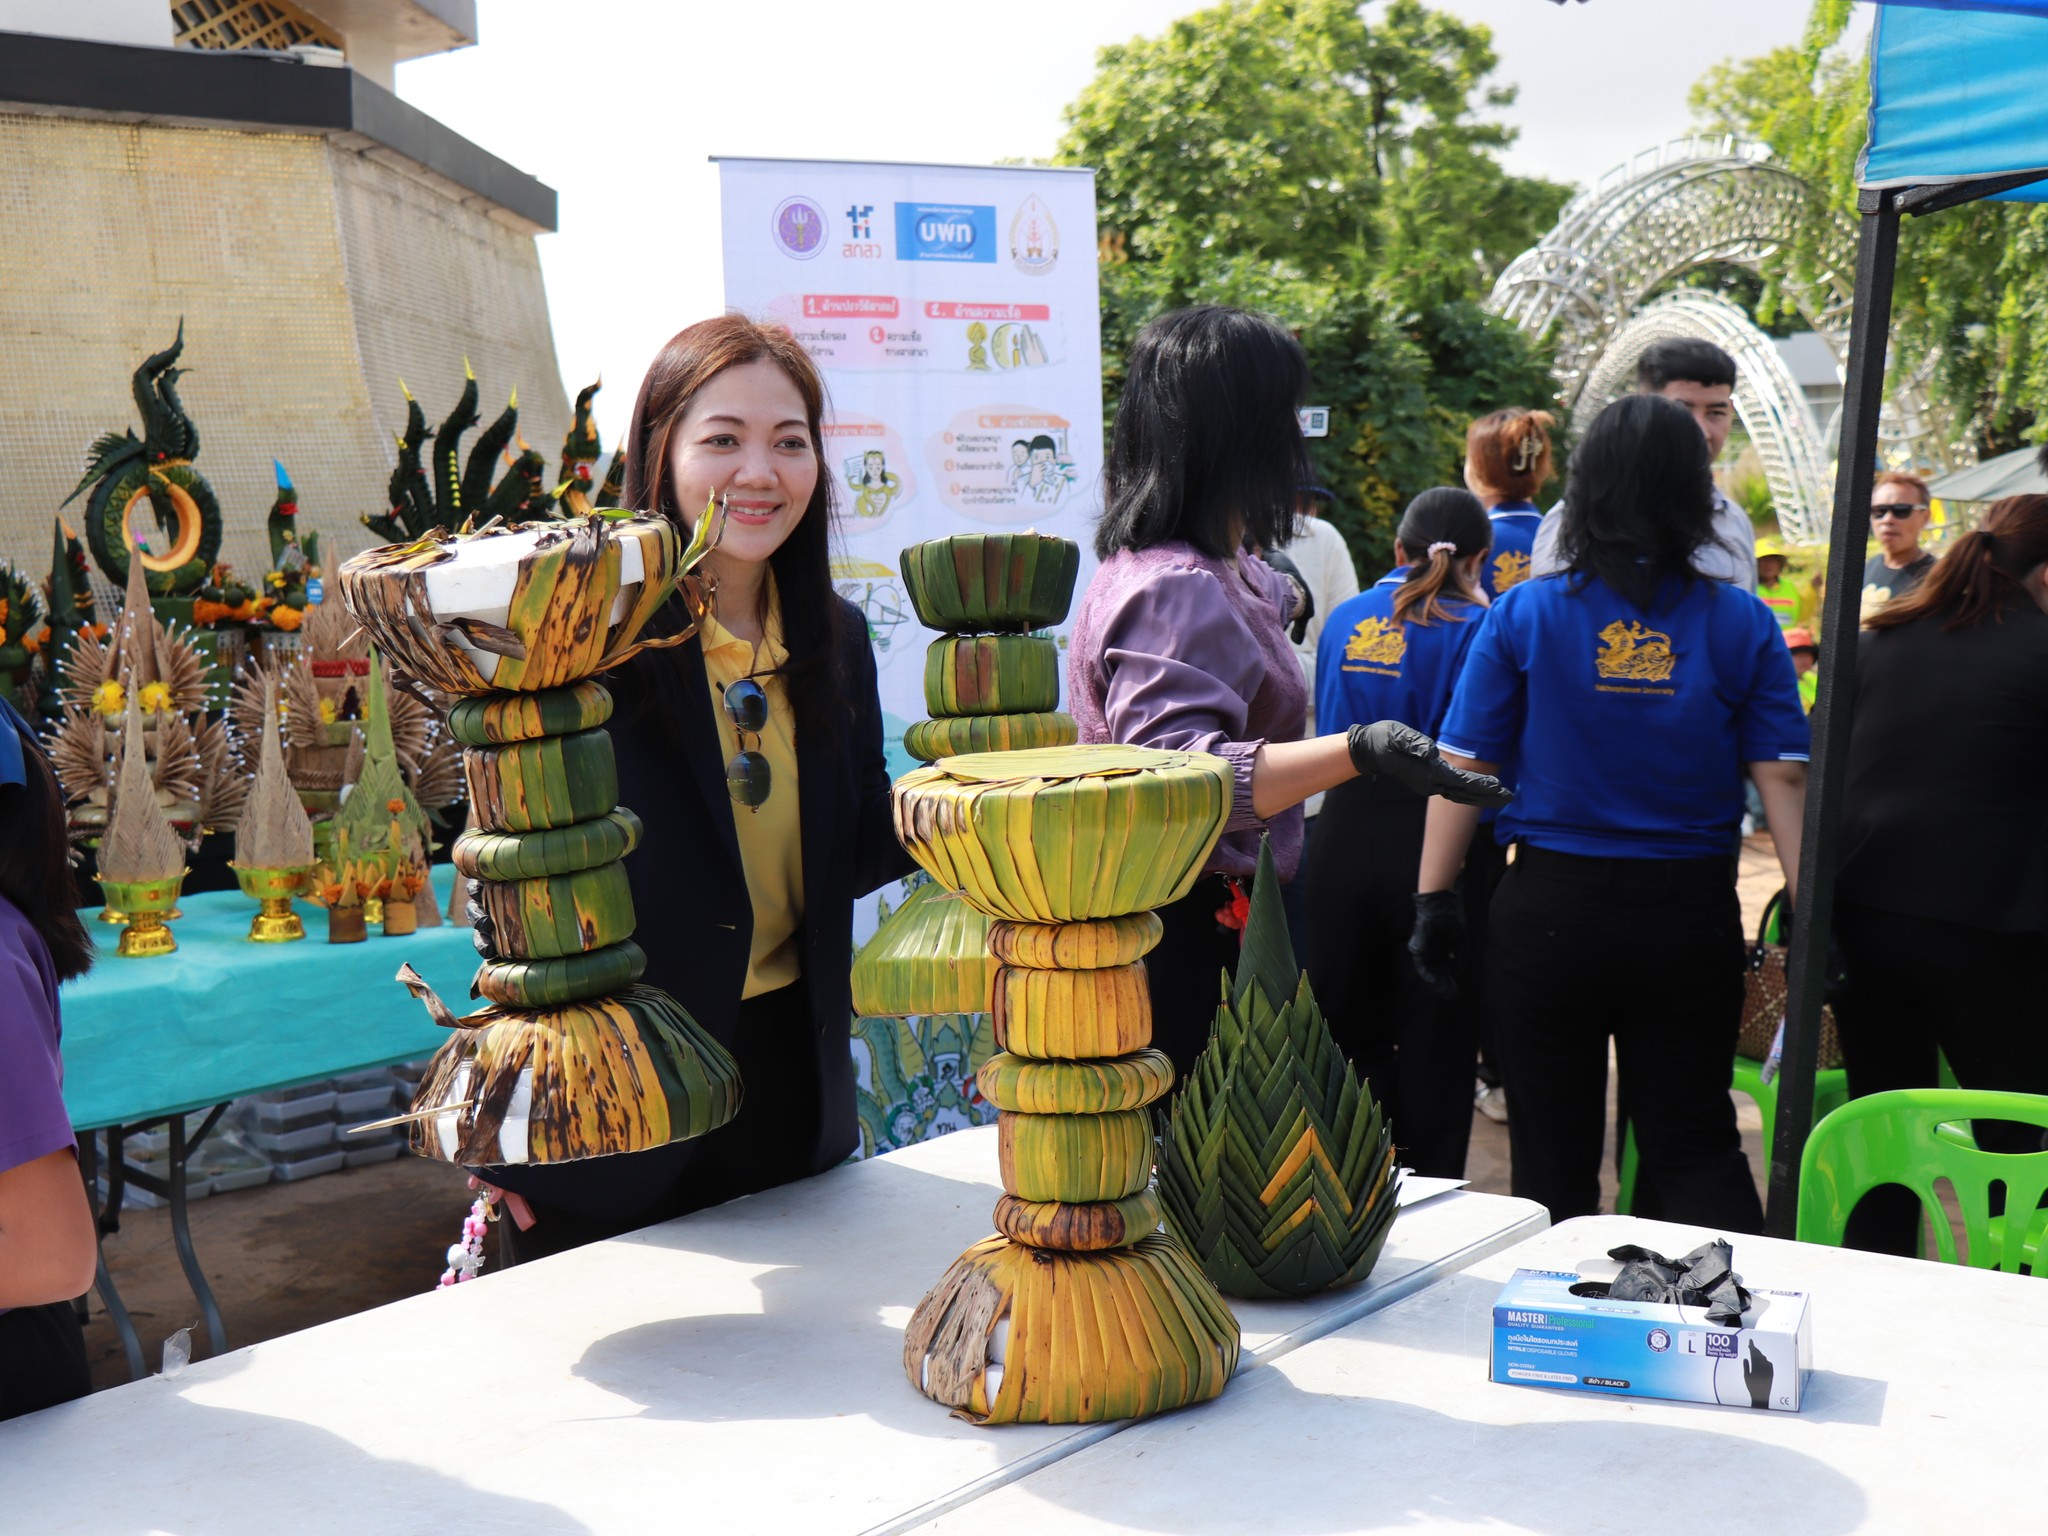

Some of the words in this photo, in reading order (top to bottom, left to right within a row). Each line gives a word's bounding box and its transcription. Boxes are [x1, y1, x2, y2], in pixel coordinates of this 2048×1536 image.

[842, 243, 882, 259] สกสว
[808, 300, 821, 315] 1.
[931, 303, 946, 317] 2.
[1507, 1311, 1545, 1324] MASTER
[1549, 1314, 1595, 1329] Professional
[1687, 1340, 1697, 1353] L
[1706, 1334, 1730, 1347] 100
[1526, 1347, 1557, 1356] DISPOSABLE
